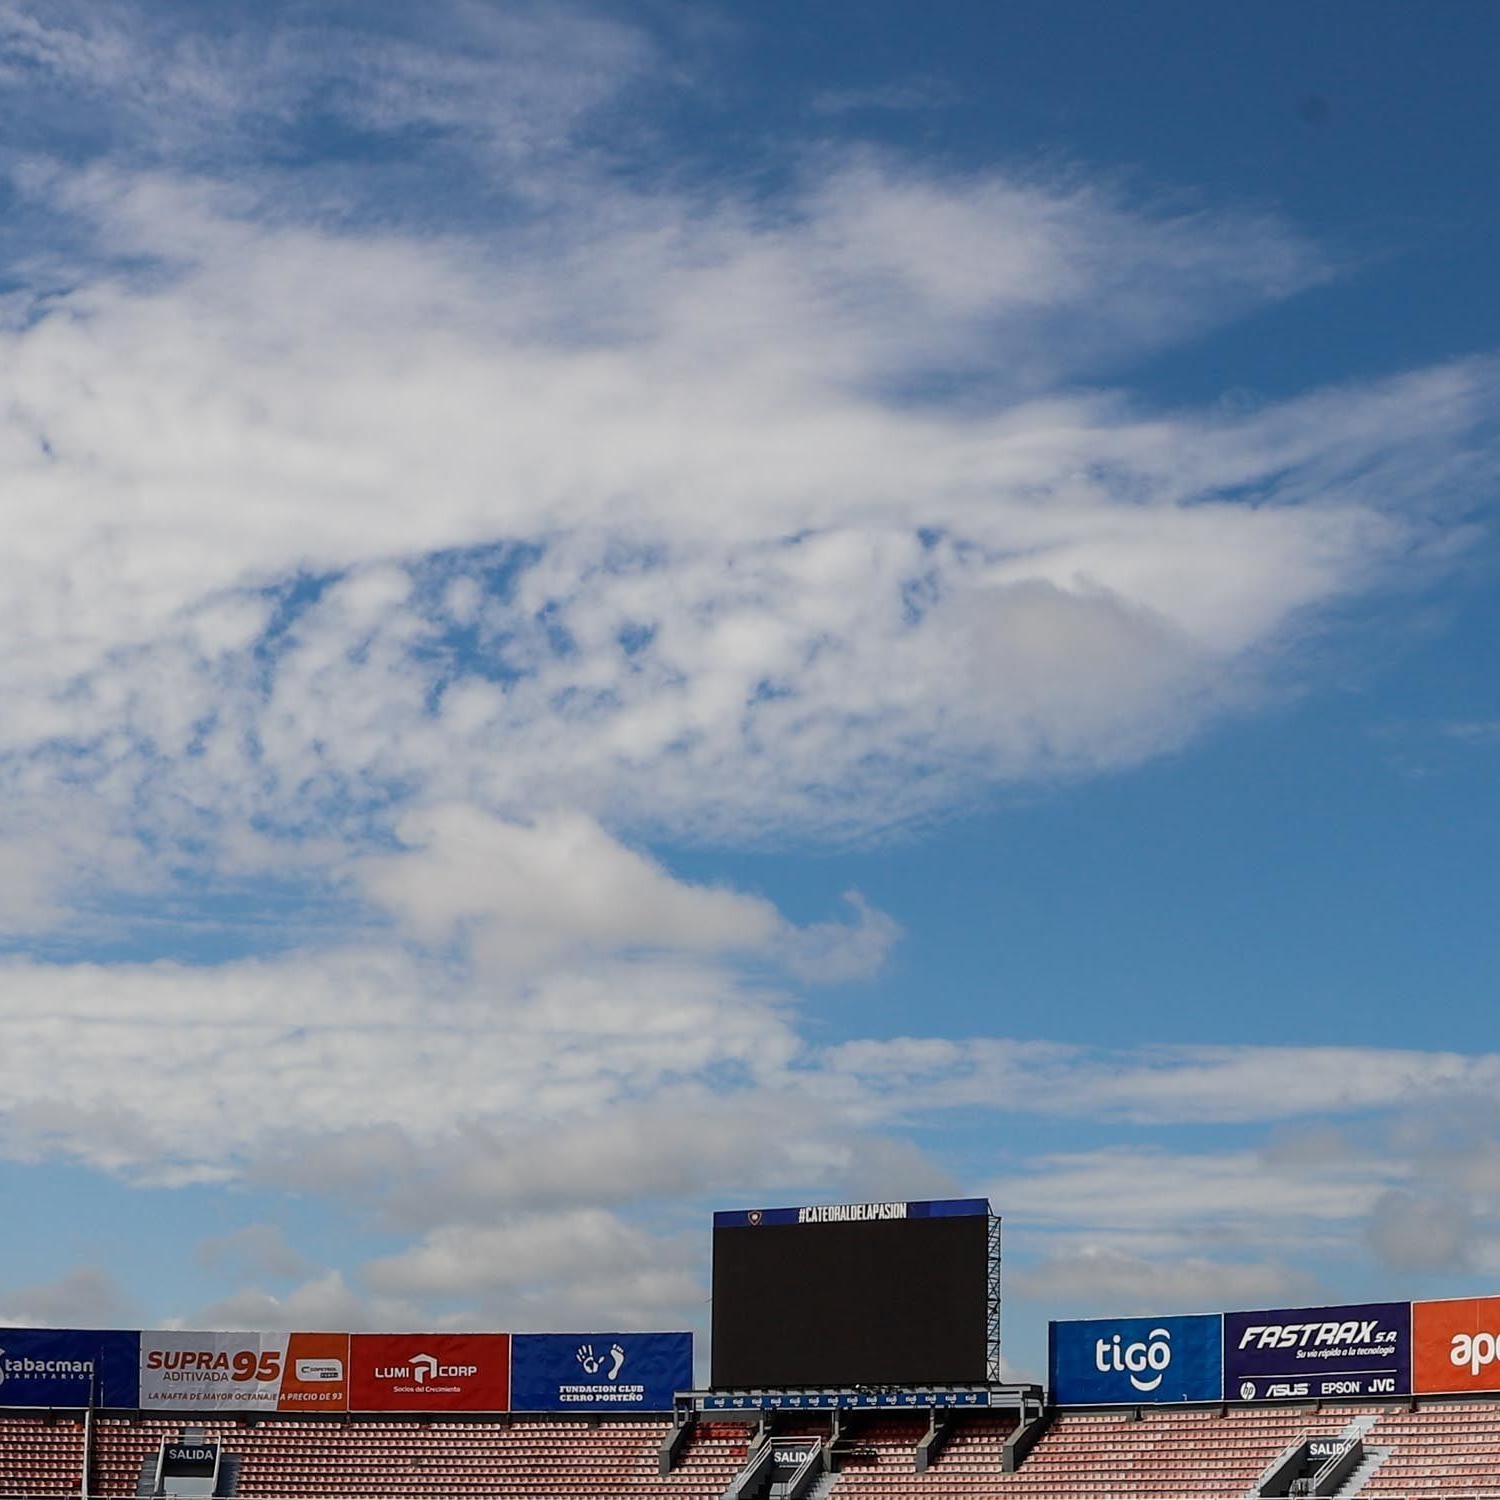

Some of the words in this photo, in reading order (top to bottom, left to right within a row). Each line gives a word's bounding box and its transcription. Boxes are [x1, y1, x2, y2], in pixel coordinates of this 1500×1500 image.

[798, 1202, 908, 1223] #CATEDRALDELAPASION
[1238, 1321, 1379, 1350] FASTRAX
[1295, 1350, 1307, 1359] Su
[5, 1358, 93, 1372] tabacman
[147, 1352, 230, 1370] SUPRA
[231, 1351, 281, 1383] 95
[163, 1371, 229, 1382] ADITIVADA
[375, 1367, 409, 1378] LUMI
[439, 1366, 477, 1377] CORP
[560, 1385, 617, 1393] FUNDACION
[618, 1385, 644, 1393] CLUB
[1266, 1383, 1308, 1397] ASUS
[1321, 1382, 1360, 1394] EPSON
[1368, 1379, 1395, 1392] JVC
[332, 1392, 343, 1400] 93
[560, 1394, 594, 1402] CERRO
[595, 1392, 644, 1402] PORTEÑO
[169, 1449, 214, 1460] SALIDA
